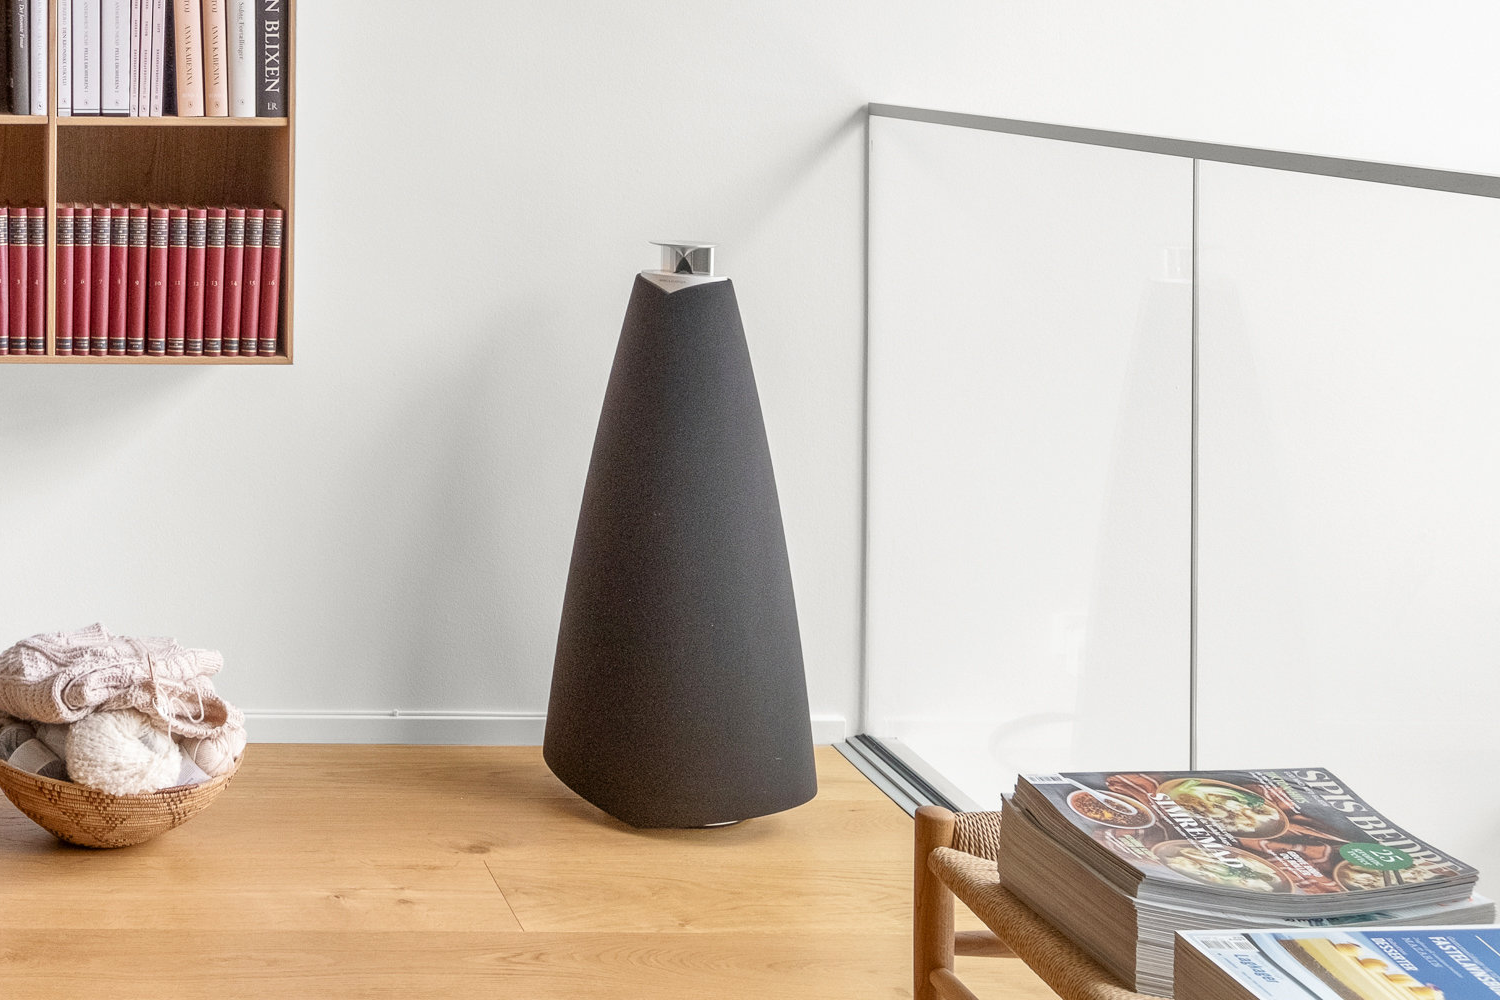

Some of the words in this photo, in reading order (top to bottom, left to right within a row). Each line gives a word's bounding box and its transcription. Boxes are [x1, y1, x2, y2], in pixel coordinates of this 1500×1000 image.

[264, 20, 279, 93] BLIXEN
[1148, 792, 1243, 868] SIMREMAD
[1296, 769, 1368, 813] SPIS
[1347, 815, 1463, 877] BEDRE
[1371, 848, 1404, 863] 25
[1371, 938, 1418, 971] DESSERTER
